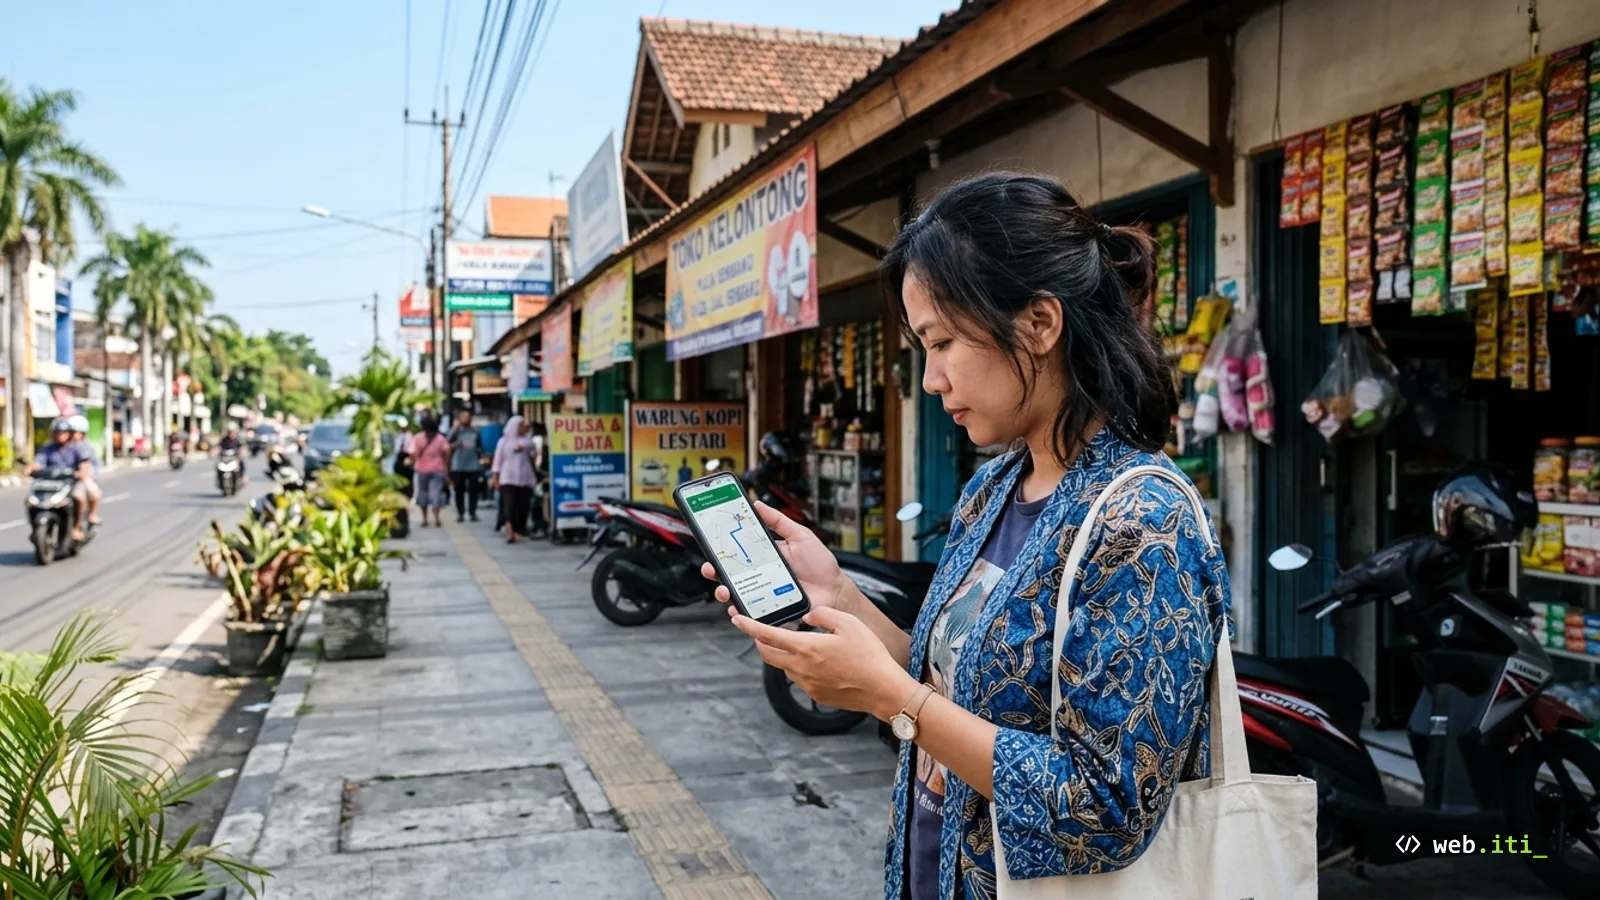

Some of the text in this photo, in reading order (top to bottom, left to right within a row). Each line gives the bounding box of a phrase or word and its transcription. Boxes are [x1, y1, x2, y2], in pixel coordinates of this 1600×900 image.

[671, 225, 703, 273] TOKO
[708, 161, 808, 255] KELONTONG
[554, 416, 621, 433] PULSA &
[635, 407, 742, 426] WARUNG KOPI
[574, 435, 614, 451] DATA
[658, 432, 727, 450] LESTARI
